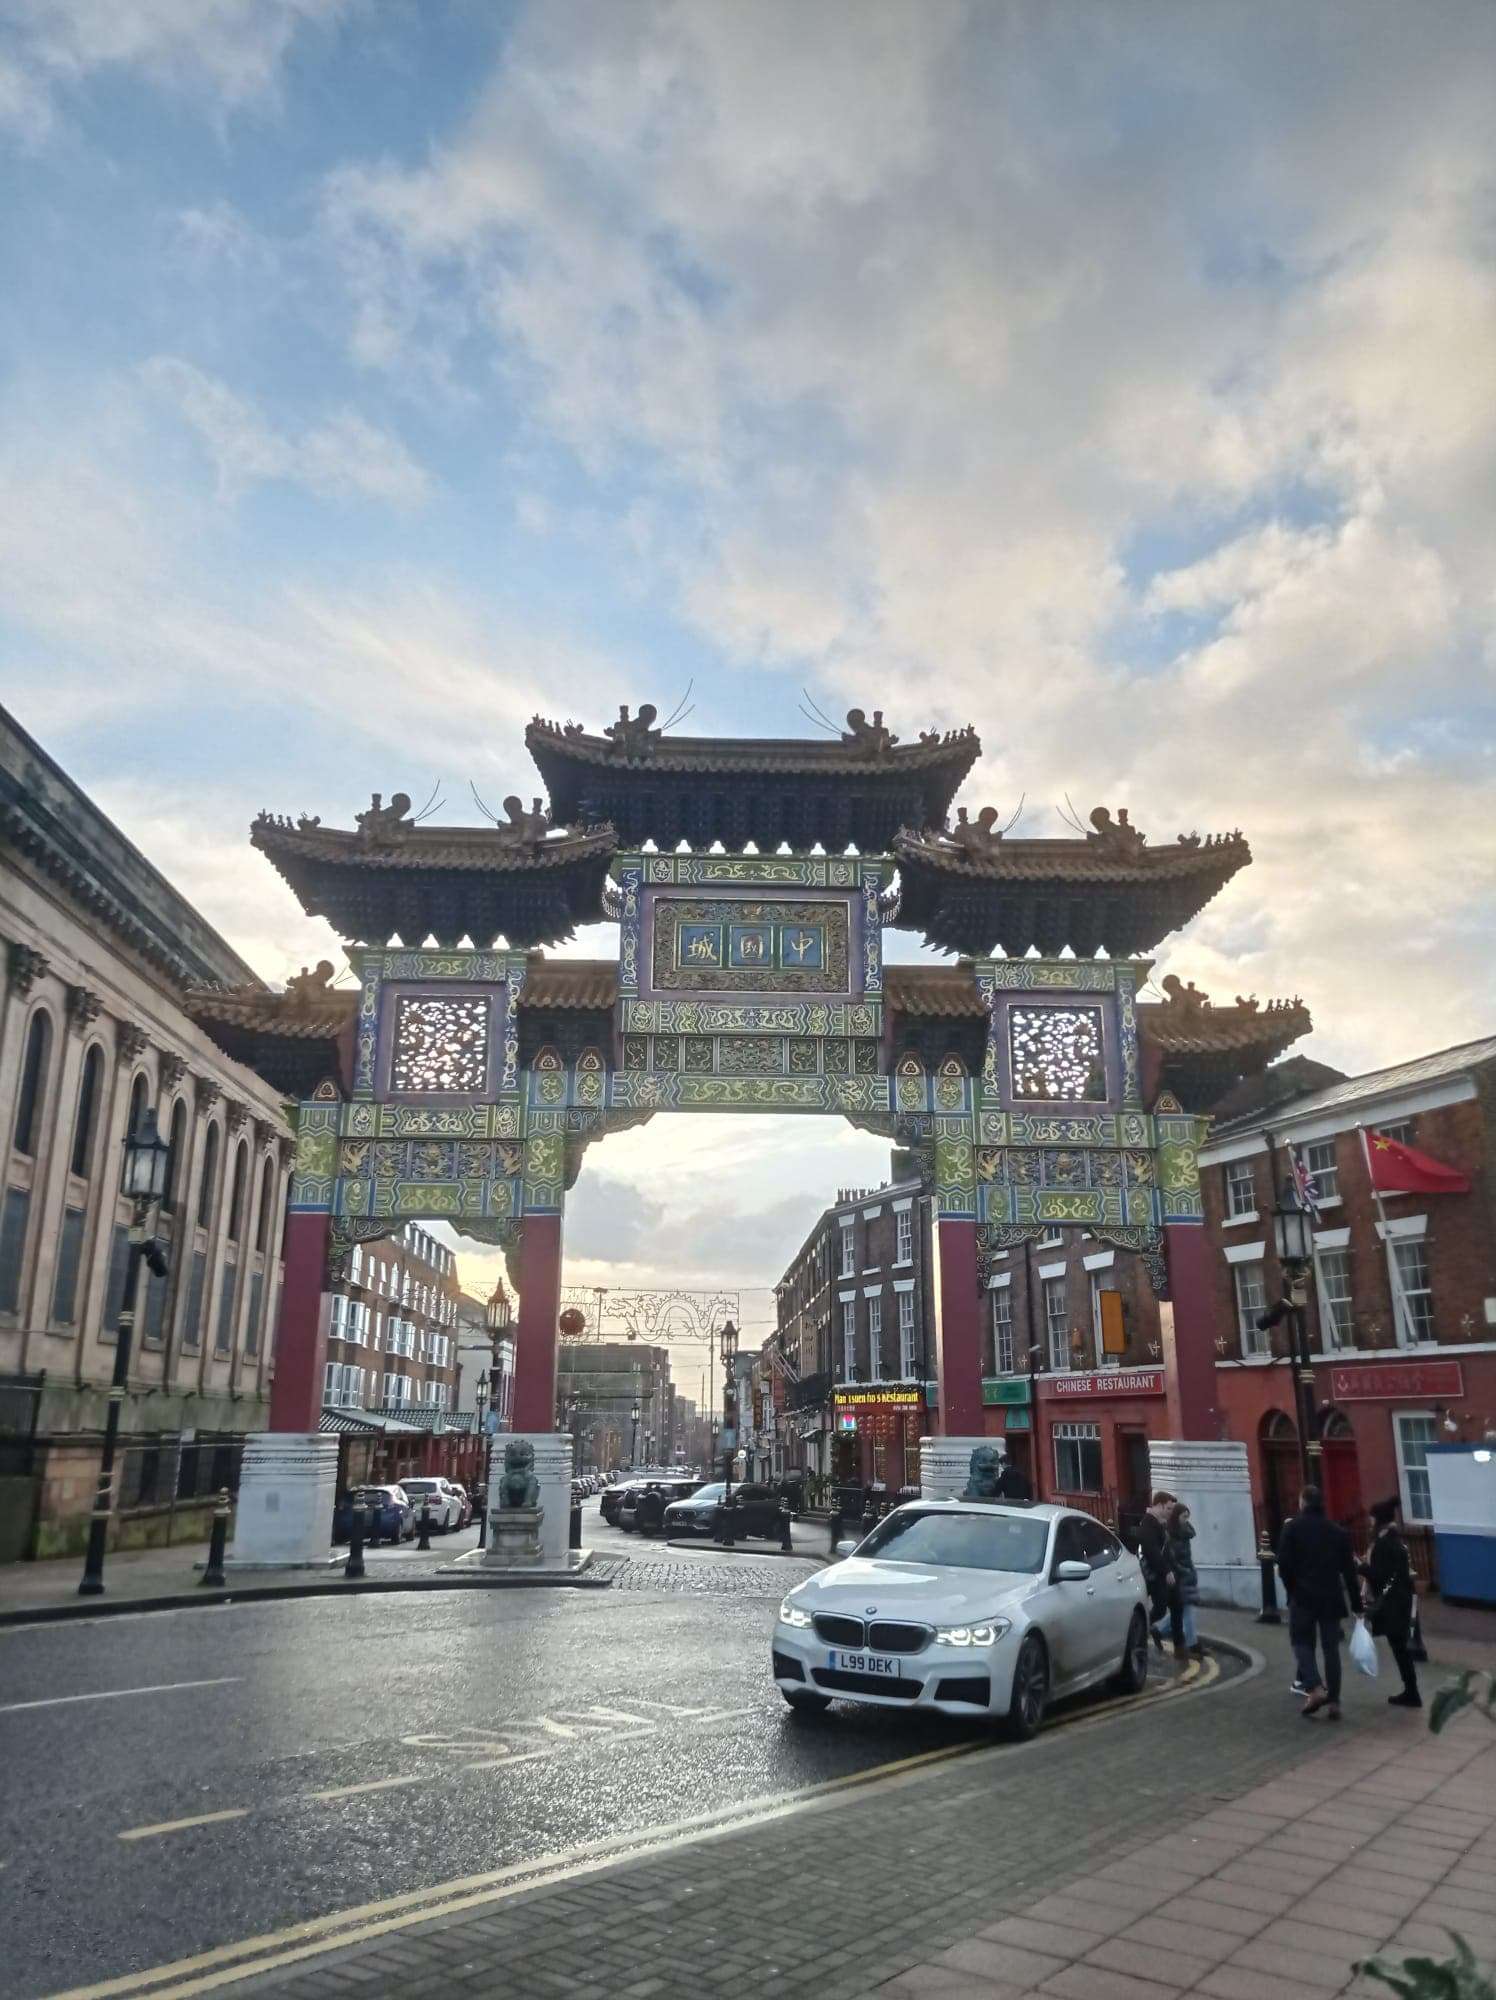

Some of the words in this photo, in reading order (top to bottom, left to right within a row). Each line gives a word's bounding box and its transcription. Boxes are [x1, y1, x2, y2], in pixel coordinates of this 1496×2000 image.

[1056, 1379, 1092, 1393] CHINESE
[1097, 1375, 1155, 1391] RESTAURANT
[881, 1391, 919, 1402] Restaurant
[841, 1654, 865, 1670] L99
[868, 1657, 893, 1673] DEK
